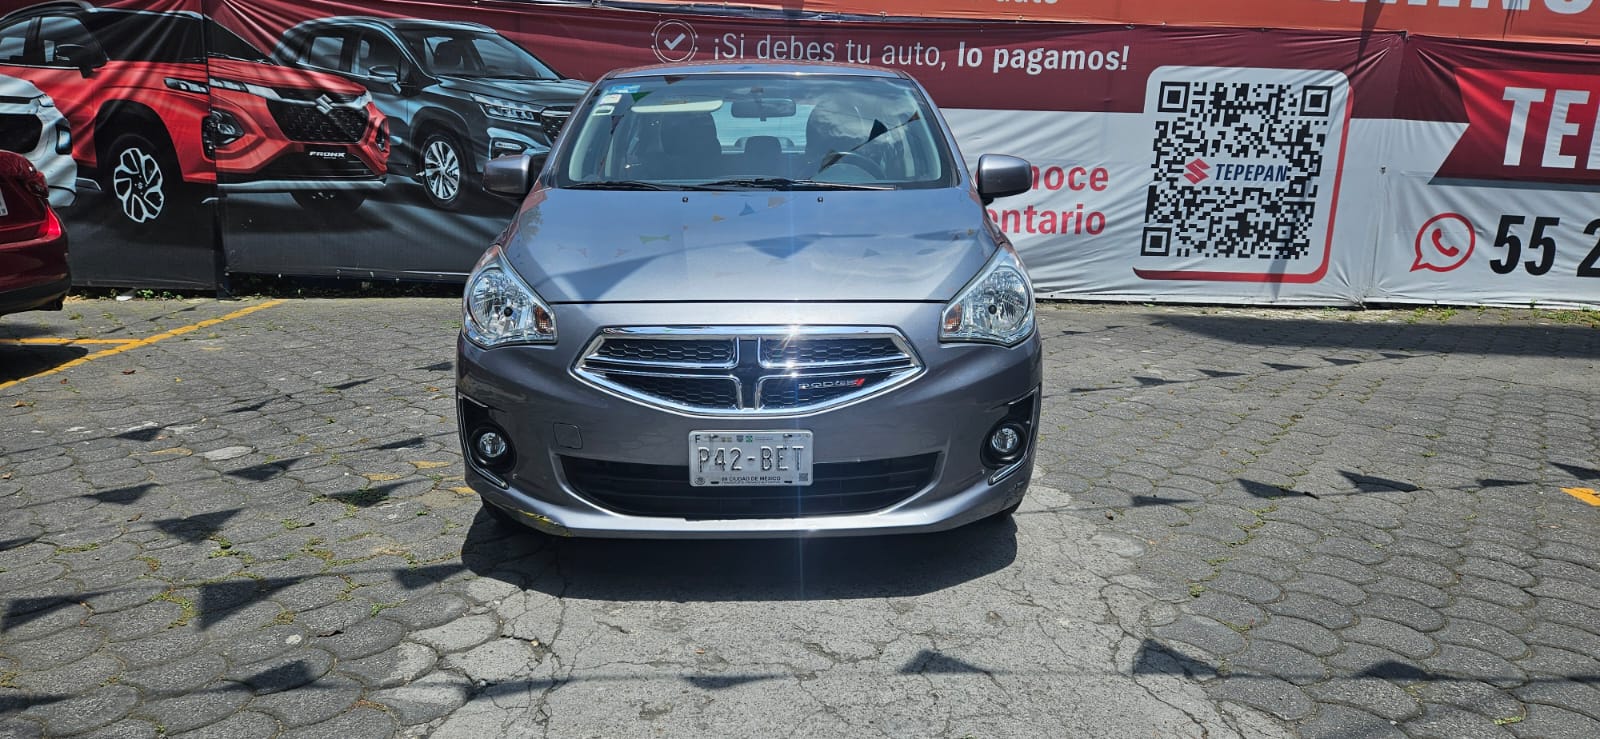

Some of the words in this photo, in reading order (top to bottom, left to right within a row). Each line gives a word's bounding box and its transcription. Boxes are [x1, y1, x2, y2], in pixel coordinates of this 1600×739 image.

[714, 32, 745, 60] ¡Si
[756, 34, 835, 62] debes
[845, 39, 871, 64] tu
[881, 41, 947, 71] auto,
[957, 41, 983, 67] lo
[992, 45, 1130, 75] pagamos!
[1502, 86, 1600, 170] TE
[1215, 163, 1288, 182] TEPEPAN
[1488, 214, 1560, 276] 55
[697, 446, 805, 472] P42-BET
